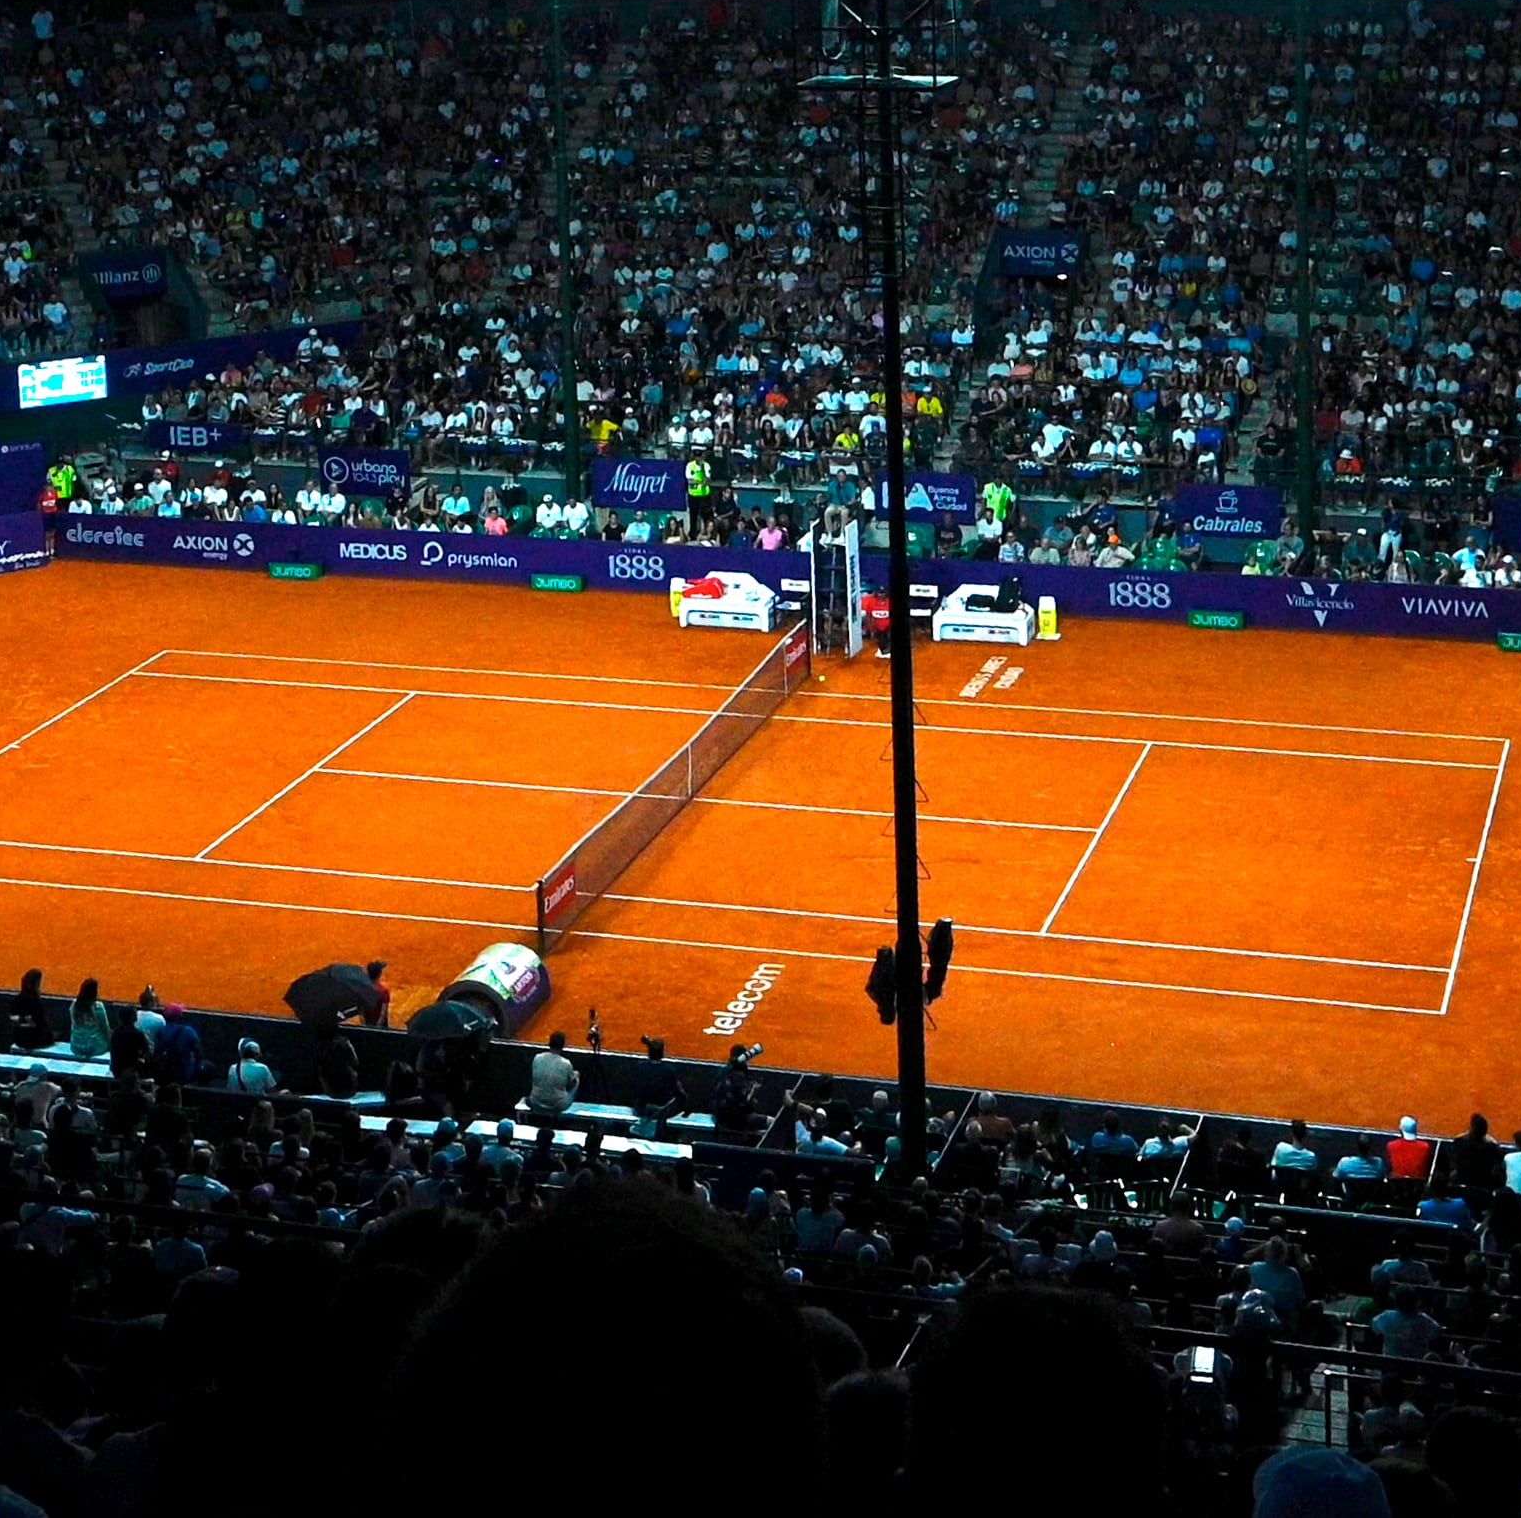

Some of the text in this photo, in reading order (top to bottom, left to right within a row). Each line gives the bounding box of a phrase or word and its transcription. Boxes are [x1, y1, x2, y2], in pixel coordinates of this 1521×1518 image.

[1003, 245, 1056, 259] AXION
[169, 425, 222, 447] IEB+
[351, 458, 398, 474] urbana
[377, 472, 406, 487] play
[603, 462, 670, 503] Magret
[928, 485, 960, 495] Buenos
[932, 494, 957, 504] Aires
[935, 501, 968, 512] Ciudad
[1193, 515, 1263, 535] Cabrales
[173, 535, 228, 552] AXION
[339, 542, 408, 561] MEDICUS
[447, 553, 518, 568] prysmian
[608, 554, 666, 581] 1888
[271, 566, 311, 578] JUMBO
[535, 577, 576, 590] JUMBO
[1109, 581, 1173, 609] 1888
[1285, 592, 1355, 611] Villavicencio
[1401, 596, 1490, 619] VIAVIVA
[1192, 613, 1239, 628] JUMBO
[703, 962, 786, 1036] telecom
